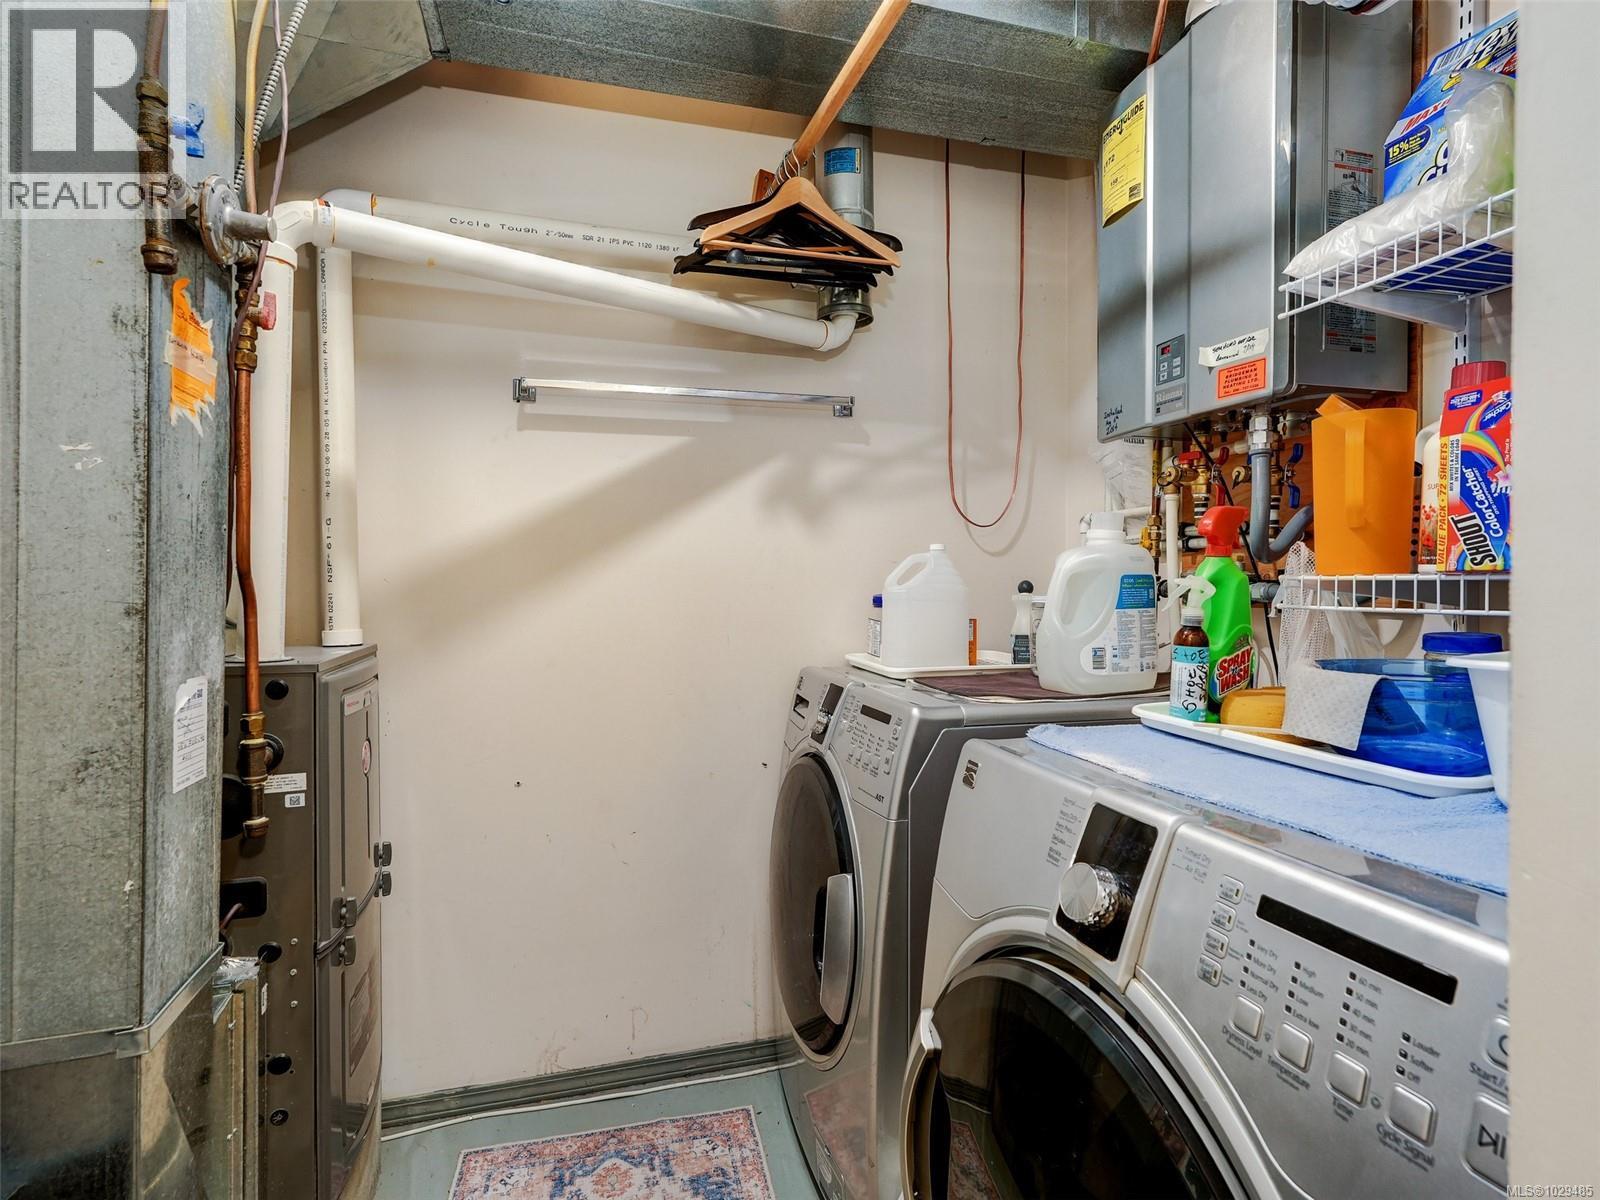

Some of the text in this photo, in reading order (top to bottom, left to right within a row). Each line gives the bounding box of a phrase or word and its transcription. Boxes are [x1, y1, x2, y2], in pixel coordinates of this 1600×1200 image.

[1388, 138, 1409, 158] 15%
[449, 217, 490, 229] Cycle
[499, 223, 539, 235] Tough
[622, 239, 635, 247] PVC
[1440, 483, 1447, 497] 72
[1437, 535, 1445, 565] VALUE
[1450, 514, 1497, 567] SHOUT
[1217, 646, 1253, 680] SPRAY
[1220, 662, 1250, 694] WASH
[1267, 964, 1276, 975] Dry
[1258, 990, 1268, 1002] Dry
[1269, 981, 1279, 992] Dry
[1412, 1038, 1440, 1058] Louder
[1410, 1055, 1434, 1073] Softer
[1376, 1122, 1402, 1146] Cycle
[1404, 1139, 1436, 1168] Signal
